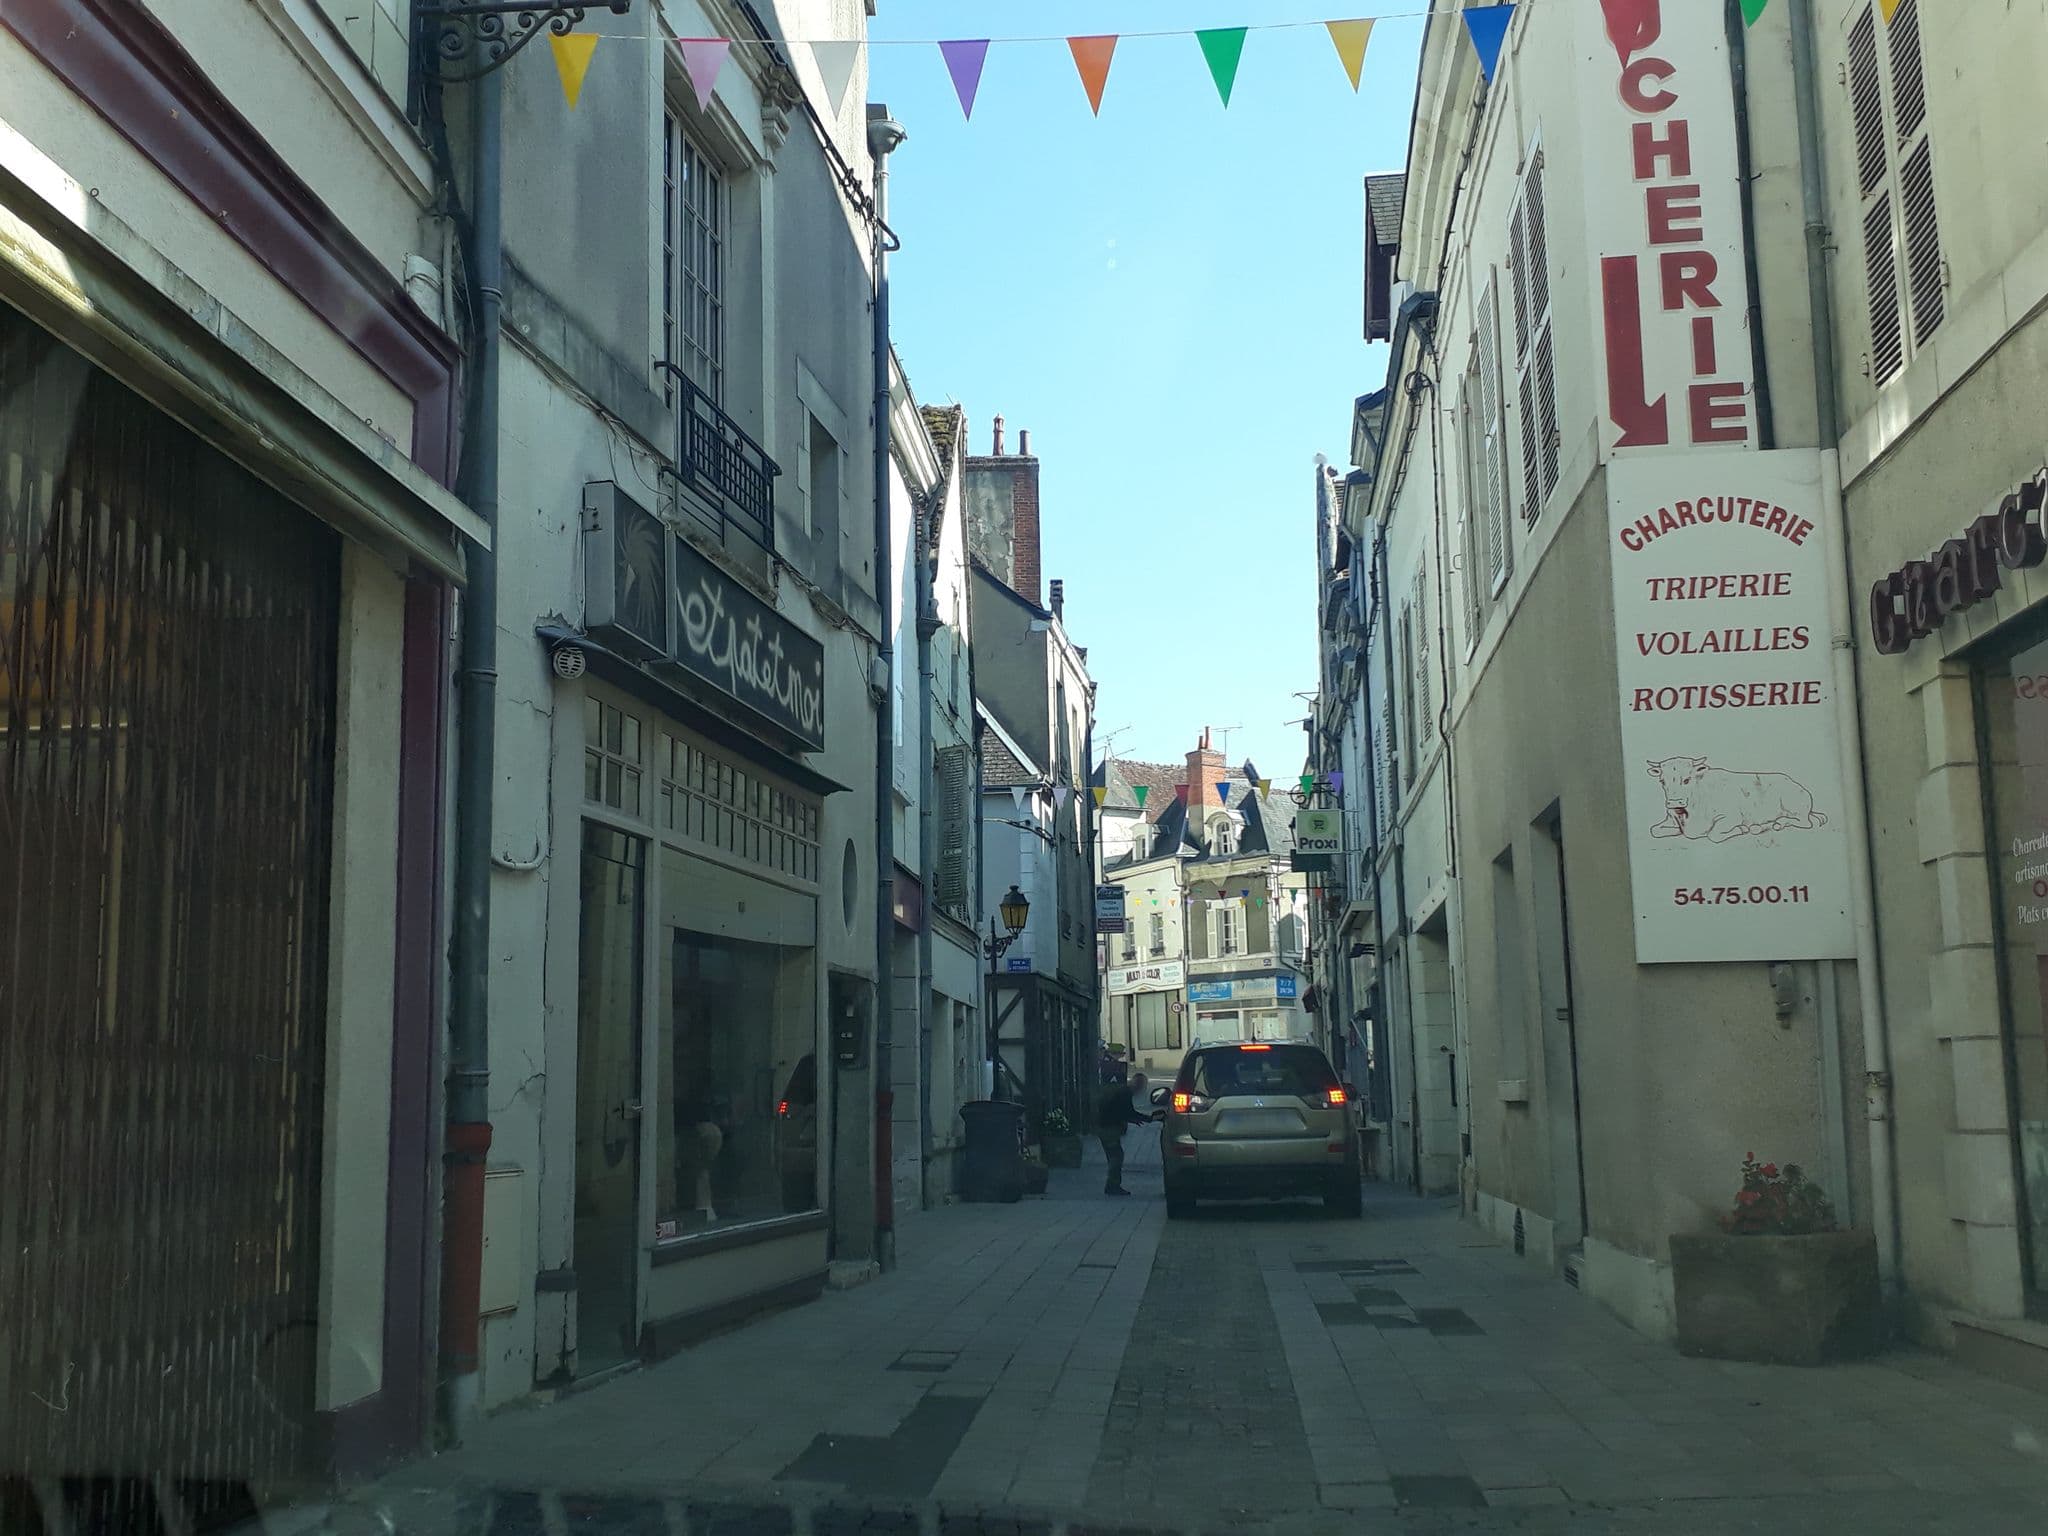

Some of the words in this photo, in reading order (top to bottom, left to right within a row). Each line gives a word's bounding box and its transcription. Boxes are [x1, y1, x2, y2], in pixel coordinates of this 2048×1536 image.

[1619, 496, 1815, 552] CHARCUTERIE
[1646, 572, 1792, 601] TRIPERIE
[1636, 625, 1810, 656] VOLAILLES
[1632, 680, 1822, 712] ROTISSERIE
[1299, 835, 1338, 850] Proxi
[1674, 885, 1809, 906] 54.75.00.11
